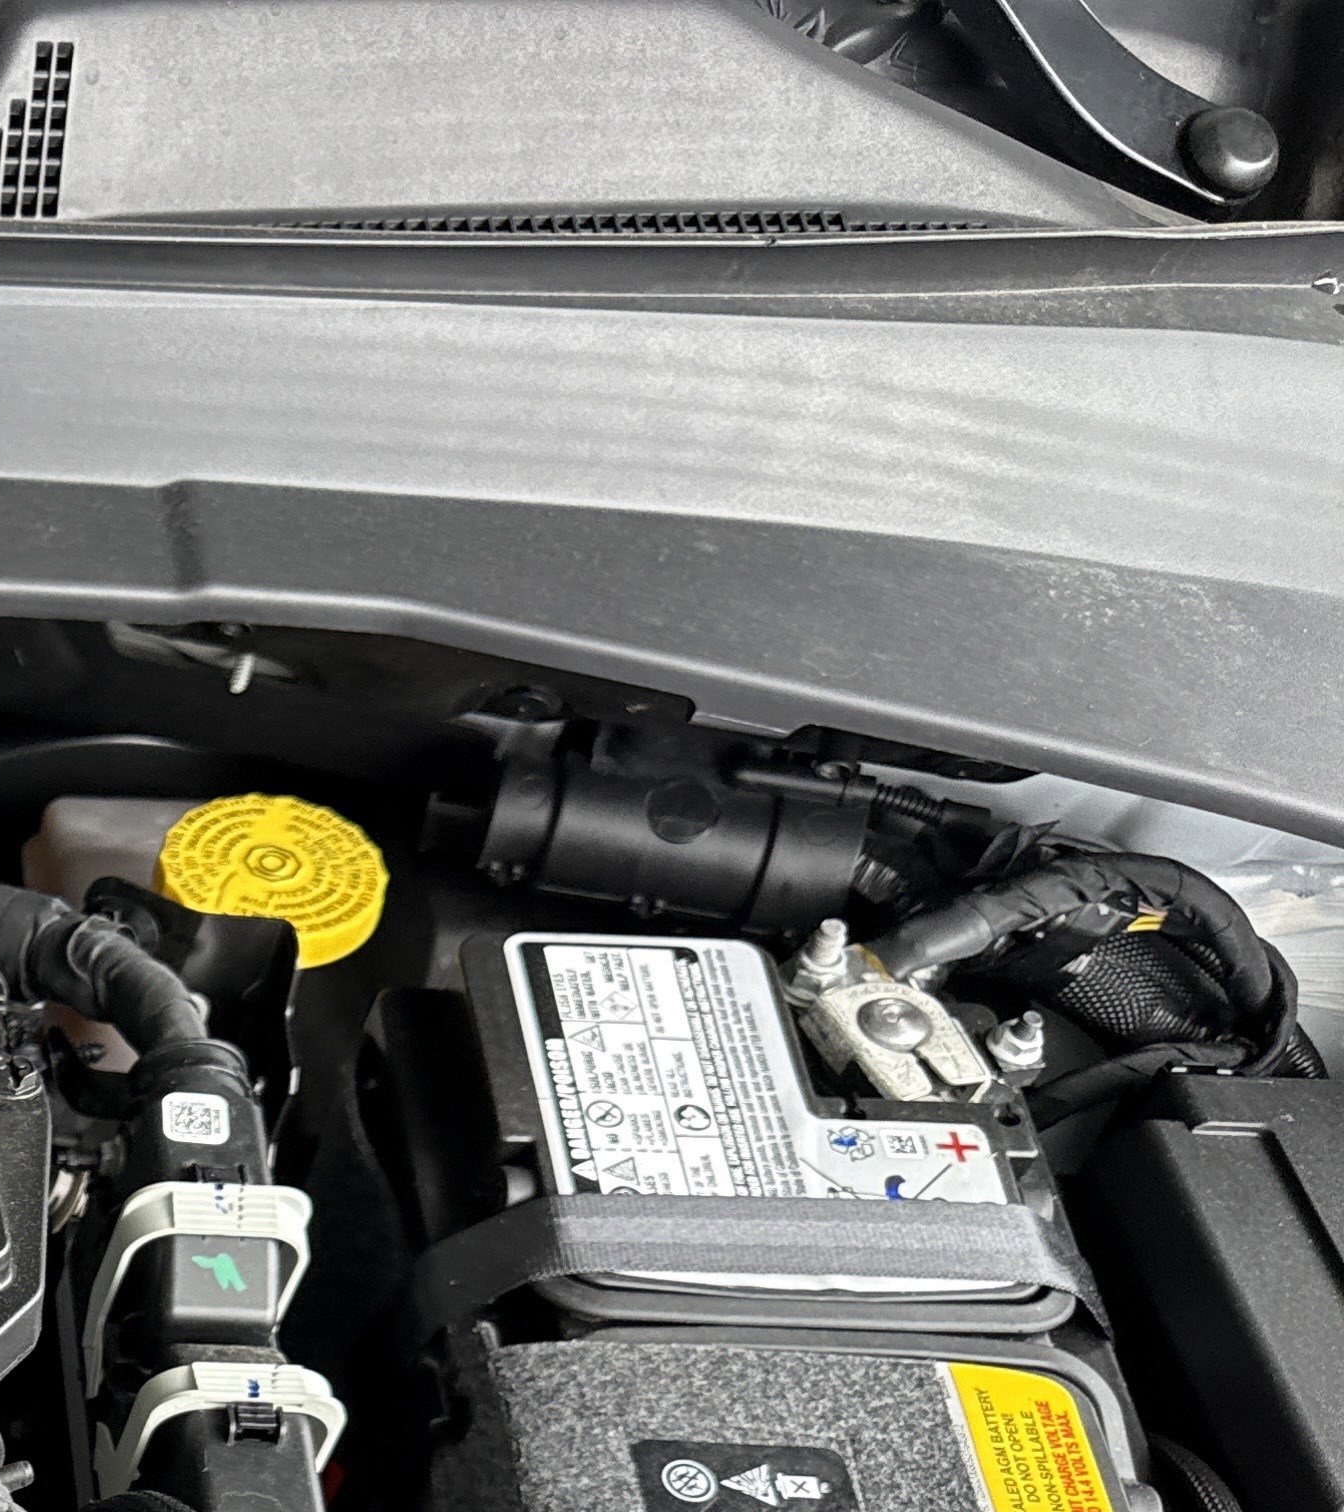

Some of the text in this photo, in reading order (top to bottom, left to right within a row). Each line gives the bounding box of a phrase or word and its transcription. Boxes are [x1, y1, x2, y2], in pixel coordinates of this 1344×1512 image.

[972, 1387, 1005, 1443] BATTERY
[1033, 1400, 1064, 1449] VOLTAGE
[991, 1446, 1014, 1475] AGM
[999, 1412, 1041, 1502] DO NOT OPEN!
[1018, 1410, 1065, 1511] NON-SPILLABLE
[1051, 1452, 1080, 1496] CHARGE
[1064, 1441, 1089, 1476] VOLTS
[1077, 1479, 1098, 1502] 14.4
